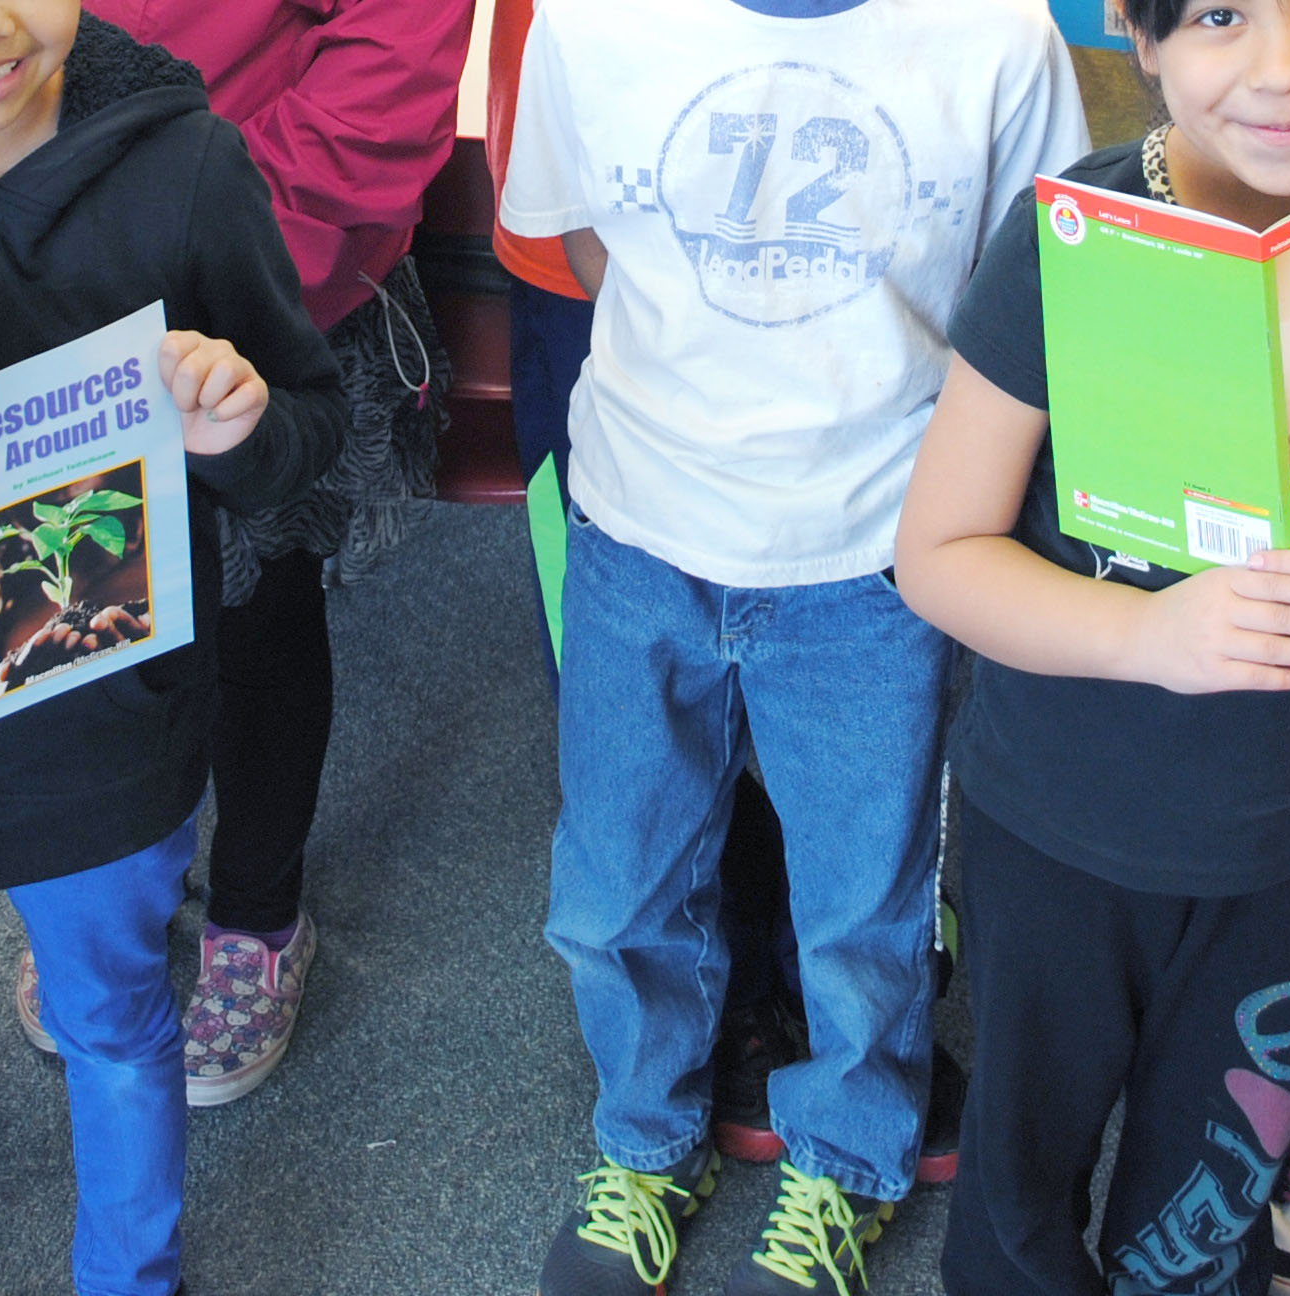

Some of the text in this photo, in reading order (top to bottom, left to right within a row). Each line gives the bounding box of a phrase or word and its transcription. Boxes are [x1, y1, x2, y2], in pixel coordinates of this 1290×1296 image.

[708, 112, 870, 226] 72
[5, 409, 108, 472] Around
[115, 398, 150, 431] Us
